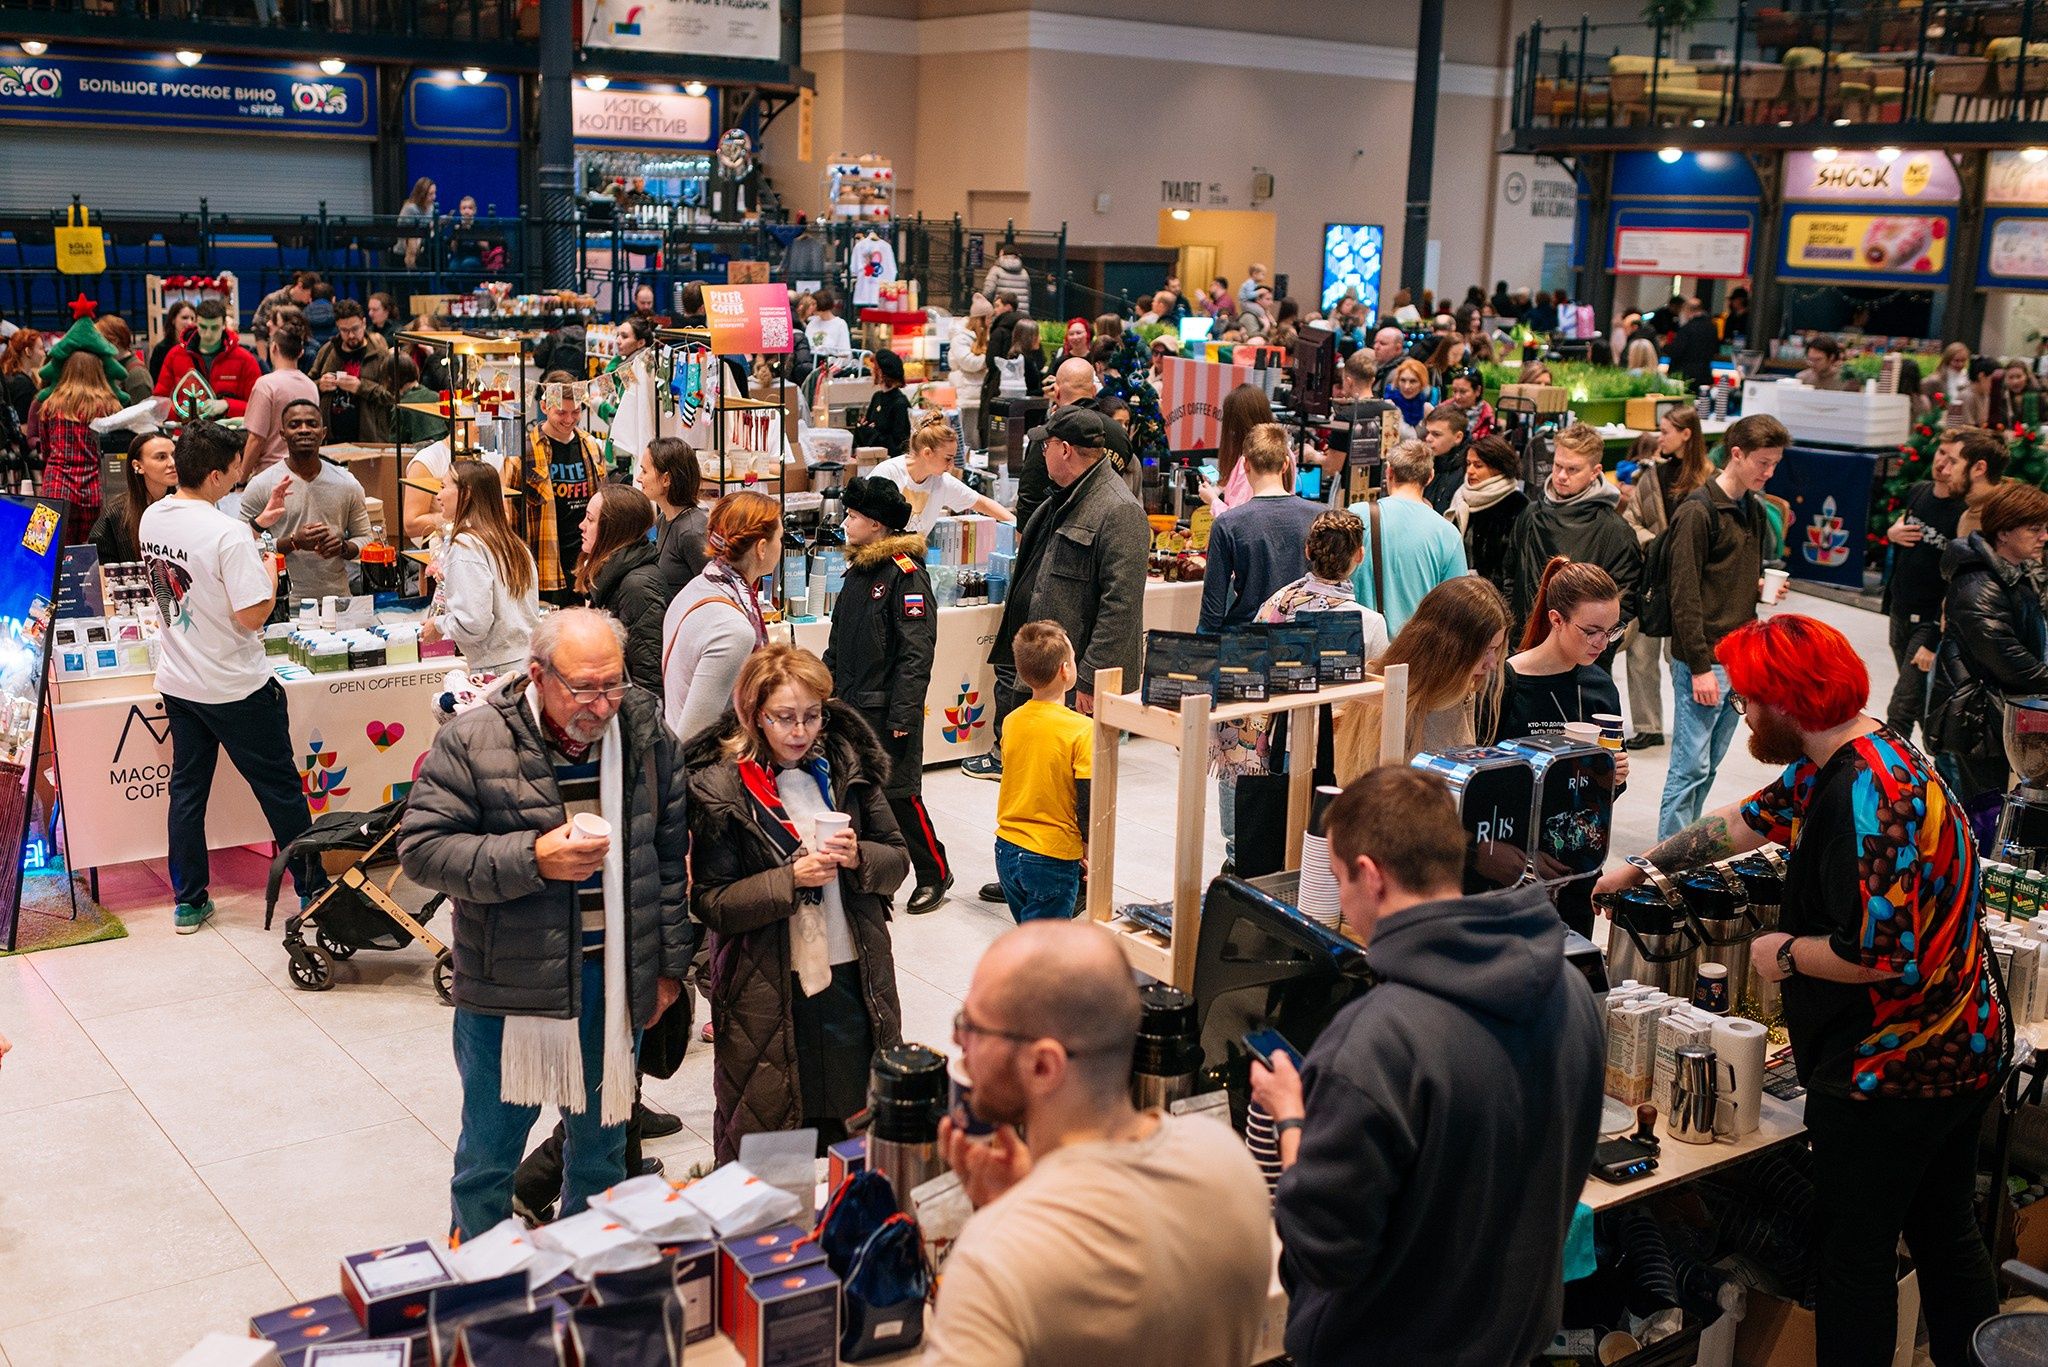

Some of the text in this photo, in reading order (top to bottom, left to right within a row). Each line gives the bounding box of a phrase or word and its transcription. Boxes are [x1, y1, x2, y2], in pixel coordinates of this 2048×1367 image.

[79, 78, 277, 101] БОЛЬШОЕ РУССКОЕ ВИНО
[250, 103, 285, 116] simple
[604, 98, 663, 115] ИСТОК
[579, 113, 687, 134] КОЛЛЕКТИВ
[1817, 165, 1890, 187] SHOCK
[710, 291, 742, 303] PITER
[711, 303, 744, 315] COFFEE
[1165, 402, 1223, 429] AUGUST COFFEE RO
[550, 462, 585, 480] PITE
[552, 481, 588, 499] COFFE
[976, 634, 998, 645] OPE
[329, 680, 366, 694] OPEN
[368, 674, 417, 690] COFFEE
[110, 764, 171, 785] MACO
[125, 782, 172, 801] COF
